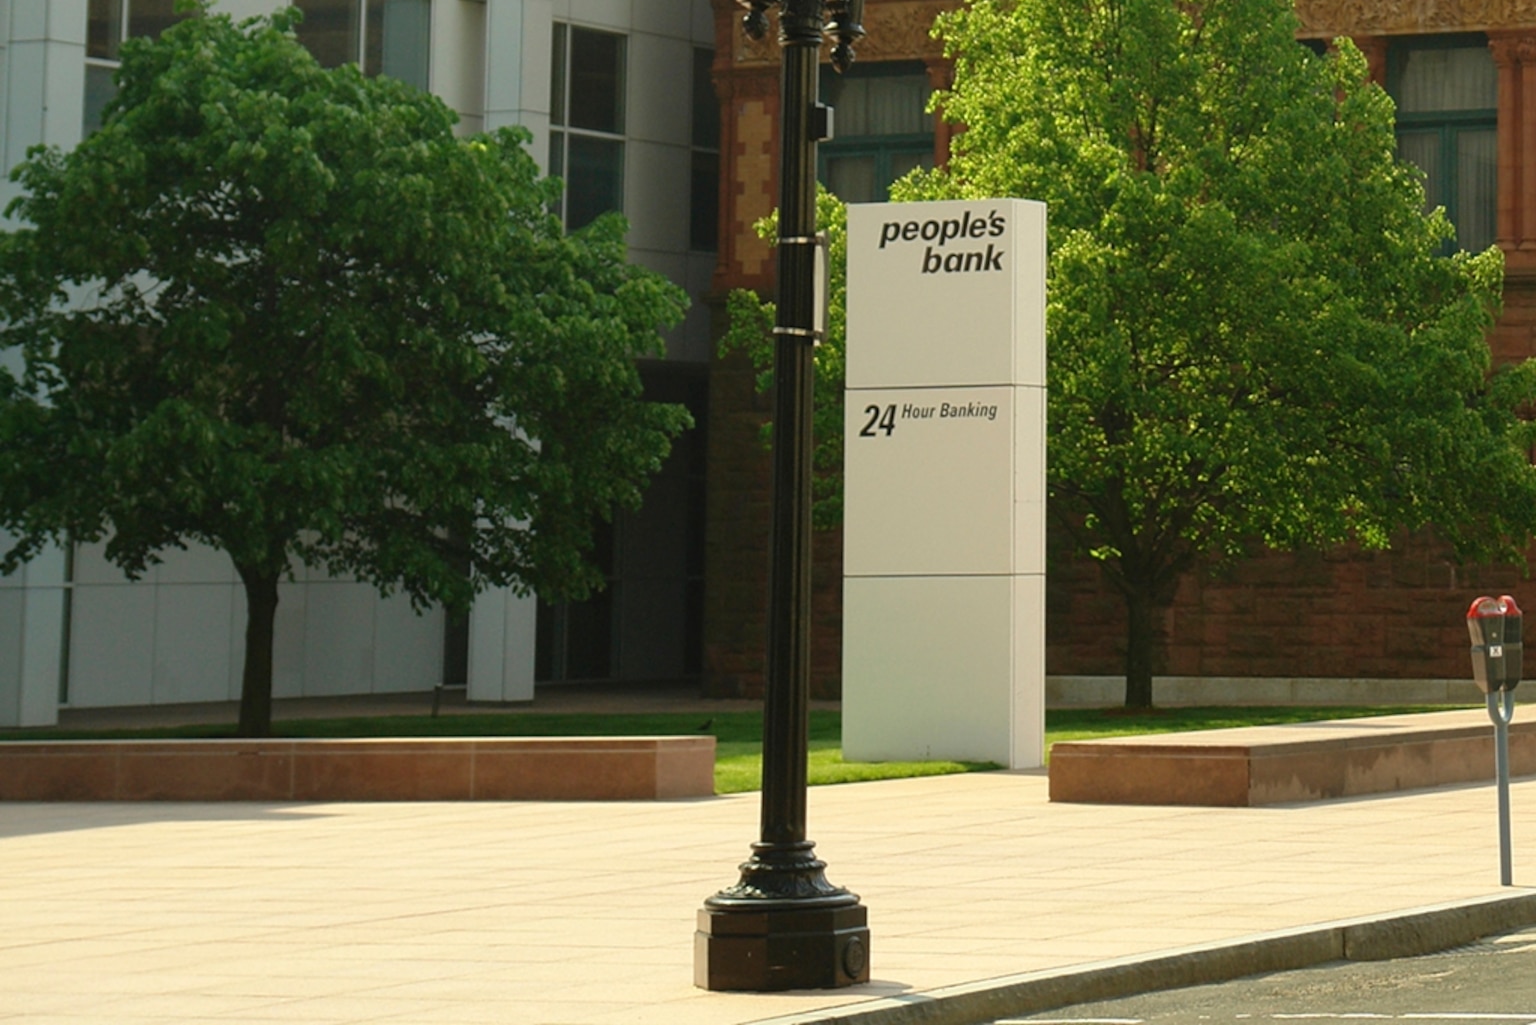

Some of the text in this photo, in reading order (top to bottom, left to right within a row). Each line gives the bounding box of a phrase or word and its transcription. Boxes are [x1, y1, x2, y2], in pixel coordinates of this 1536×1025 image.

[878, 209, 1007, 249] people's
[921, 243, 1006, 274] bank
[858, 400, 998, 438] 24 Hour Banking
